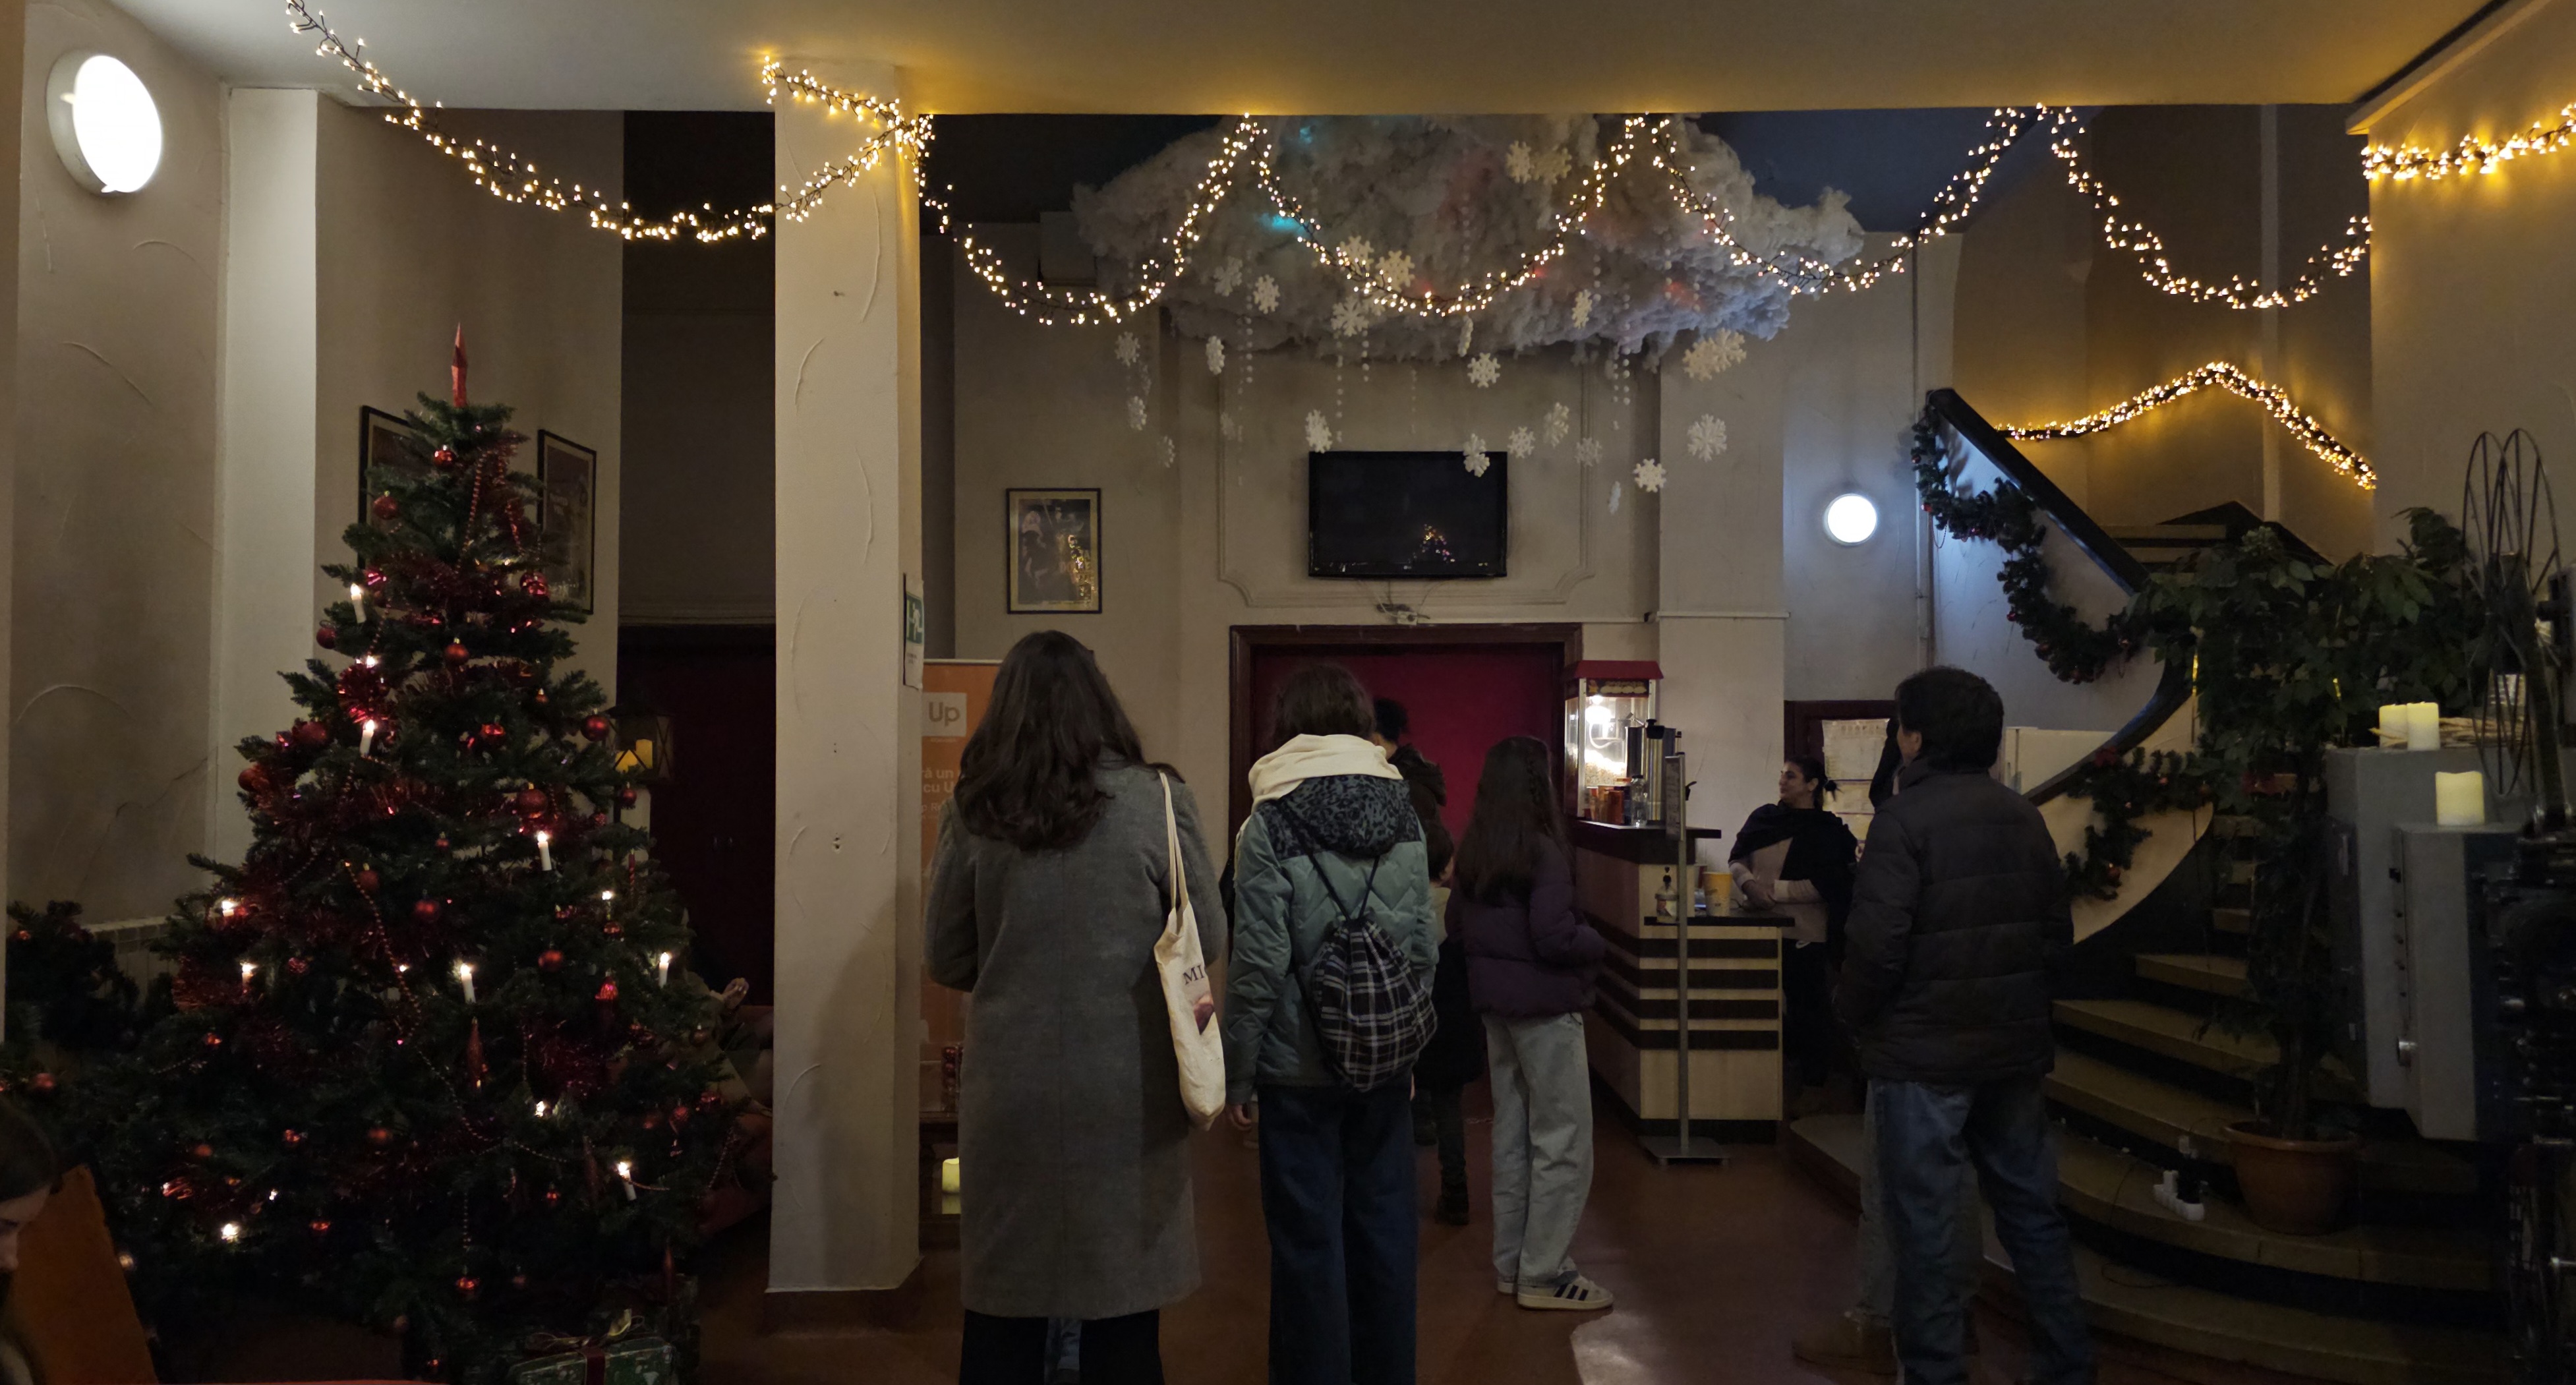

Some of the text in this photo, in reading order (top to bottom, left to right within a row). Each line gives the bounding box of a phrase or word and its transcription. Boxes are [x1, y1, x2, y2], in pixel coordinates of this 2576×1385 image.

[929, 701, 960, 726] Up
[936, 769, 954, 779] un
[923, 784, 940, 793] cu
